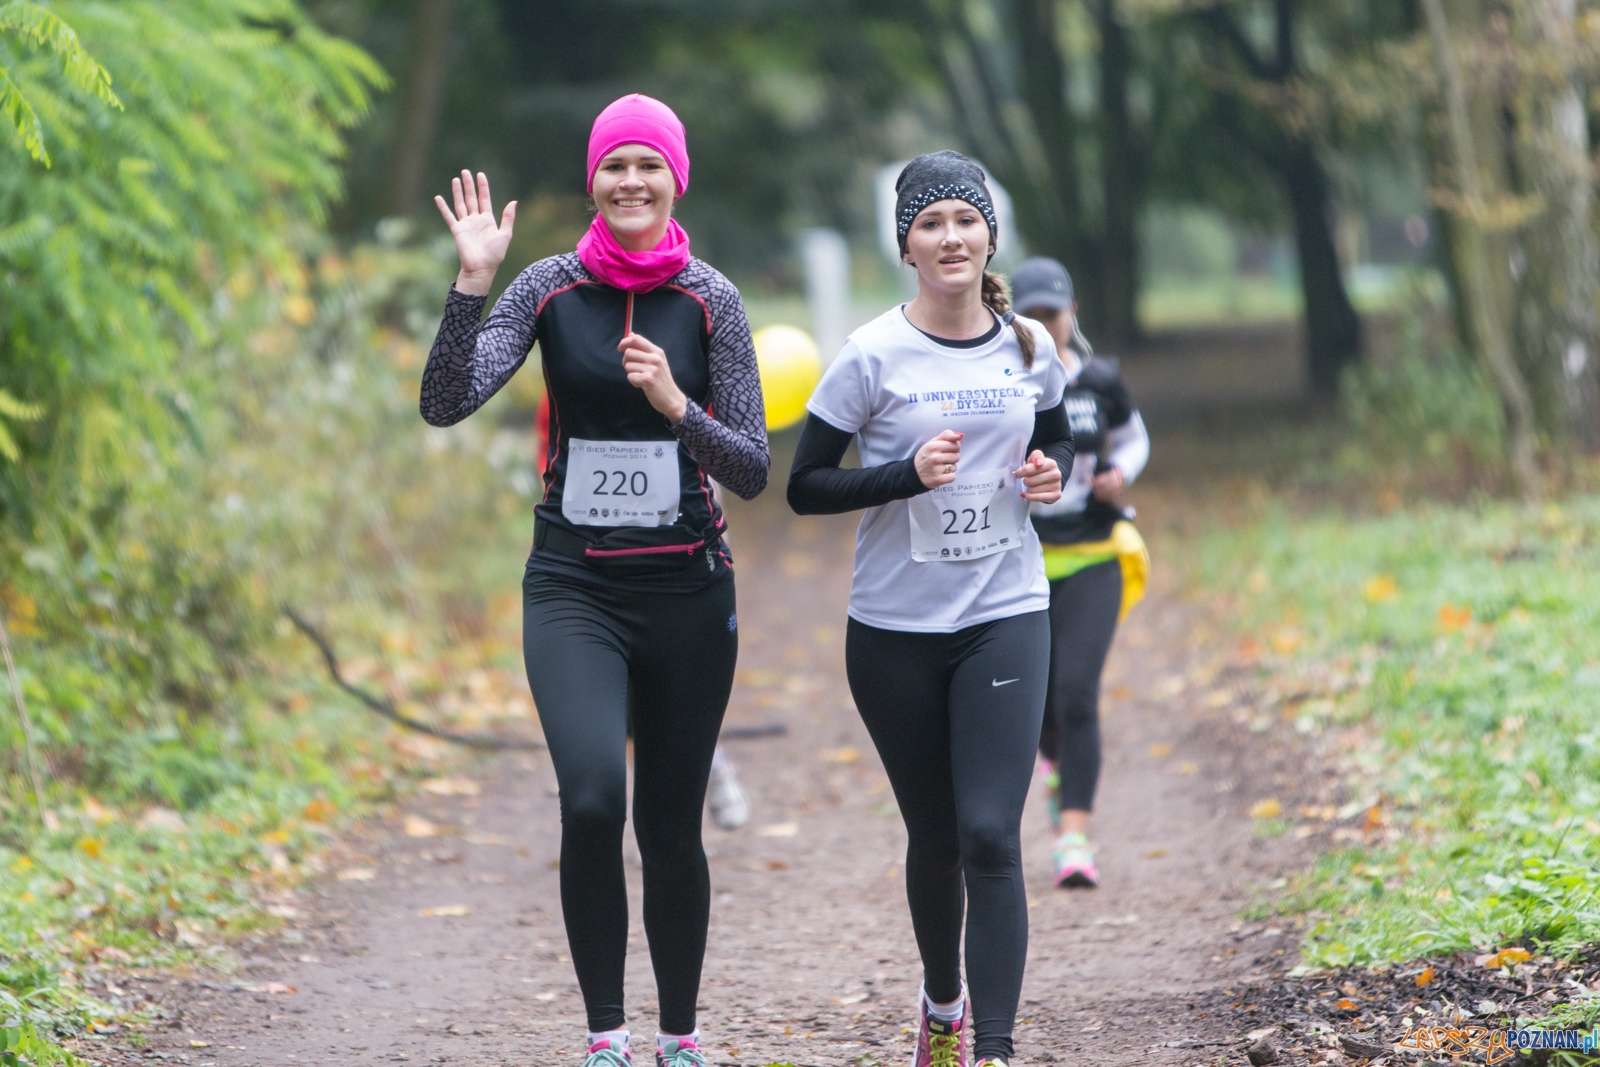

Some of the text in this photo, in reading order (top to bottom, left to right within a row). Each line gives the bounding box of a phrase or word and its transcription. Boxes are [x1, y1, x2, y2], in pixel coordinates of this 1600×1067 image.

[908, 393, 918, 403] II
[593, 470, 648, 496] 220
[942, 505, 991, 535] 221
